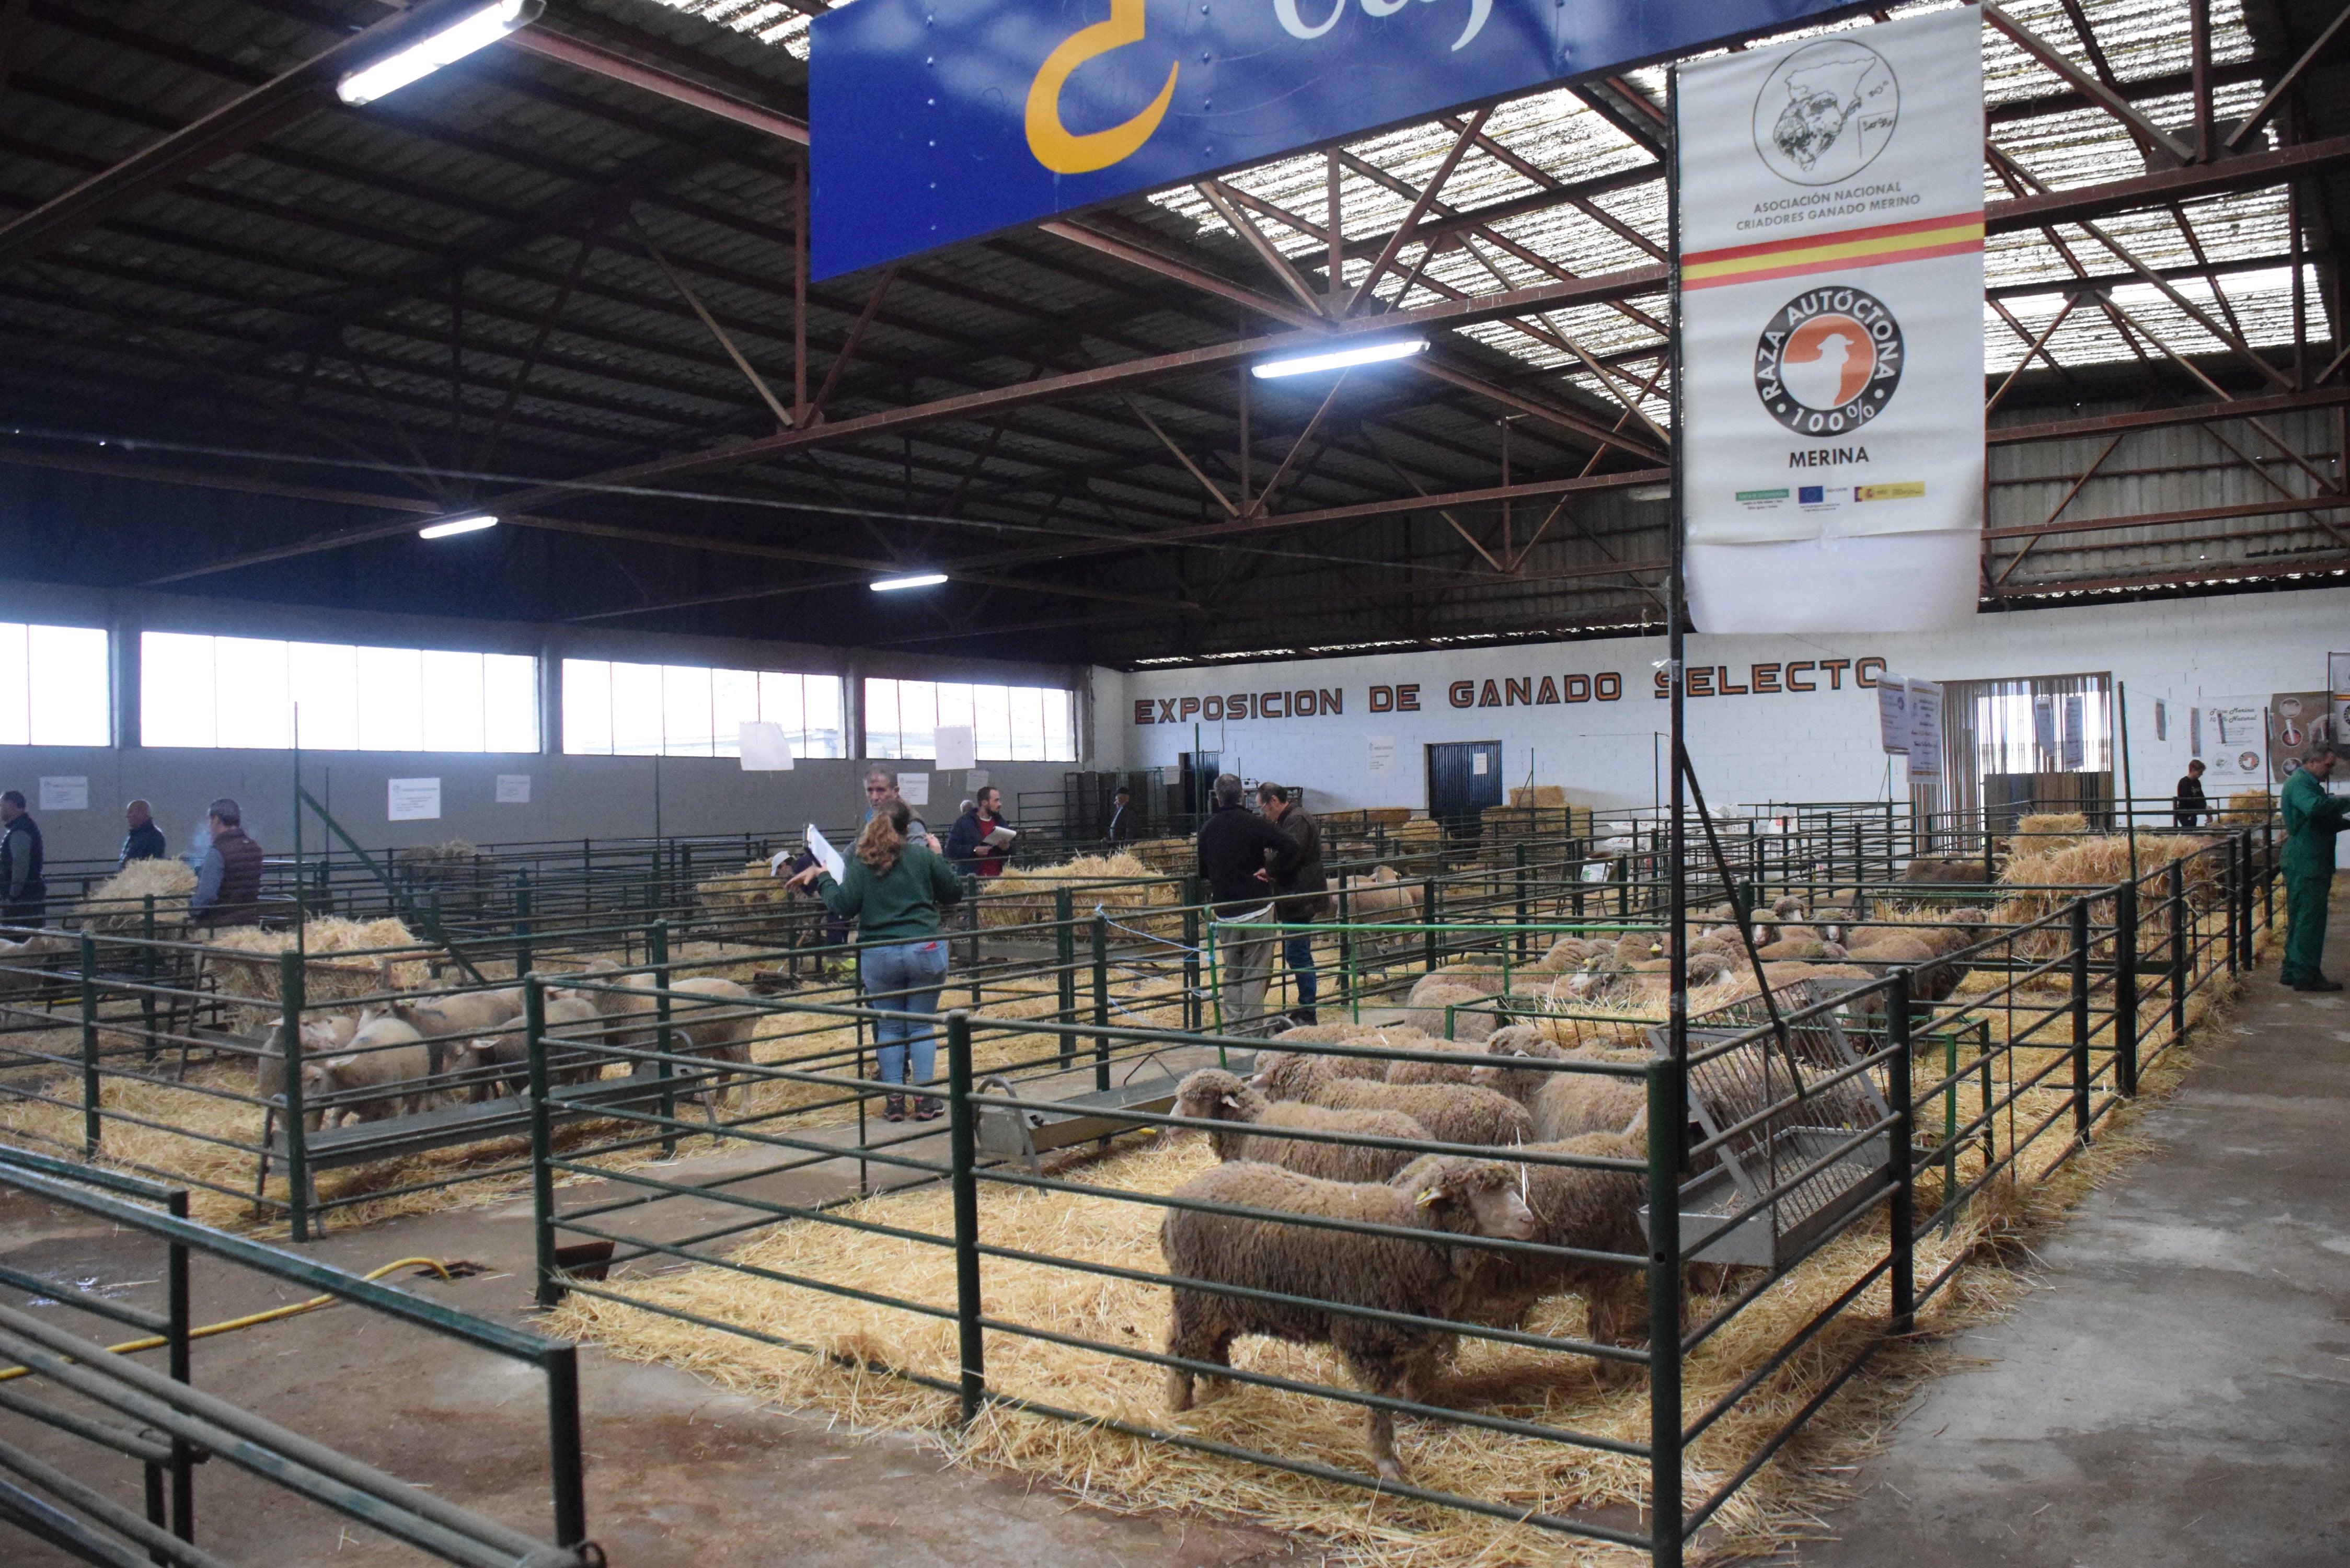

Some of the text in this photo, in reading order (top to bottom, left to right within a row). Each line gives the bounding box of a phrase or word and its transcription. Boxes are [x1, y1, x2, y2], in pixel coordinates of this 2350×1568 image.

[1736, 194, 1920, 230] CRIADORES GANADO MERINO
[1754, 181, 1902, 213] ASOCIACIÓN NACIONAL
[1757, 290, 1898, 401] RAZA AUTÓCTONA
[1791, 399, 1874, 432] 100%
[1789, 446, 1869, 468] MERINA
[1134, 688, 1343, 725] EXPOSICION
[1369, 684, 1421, 713] DE
[1448, 672, 1622, 708] GANADO
